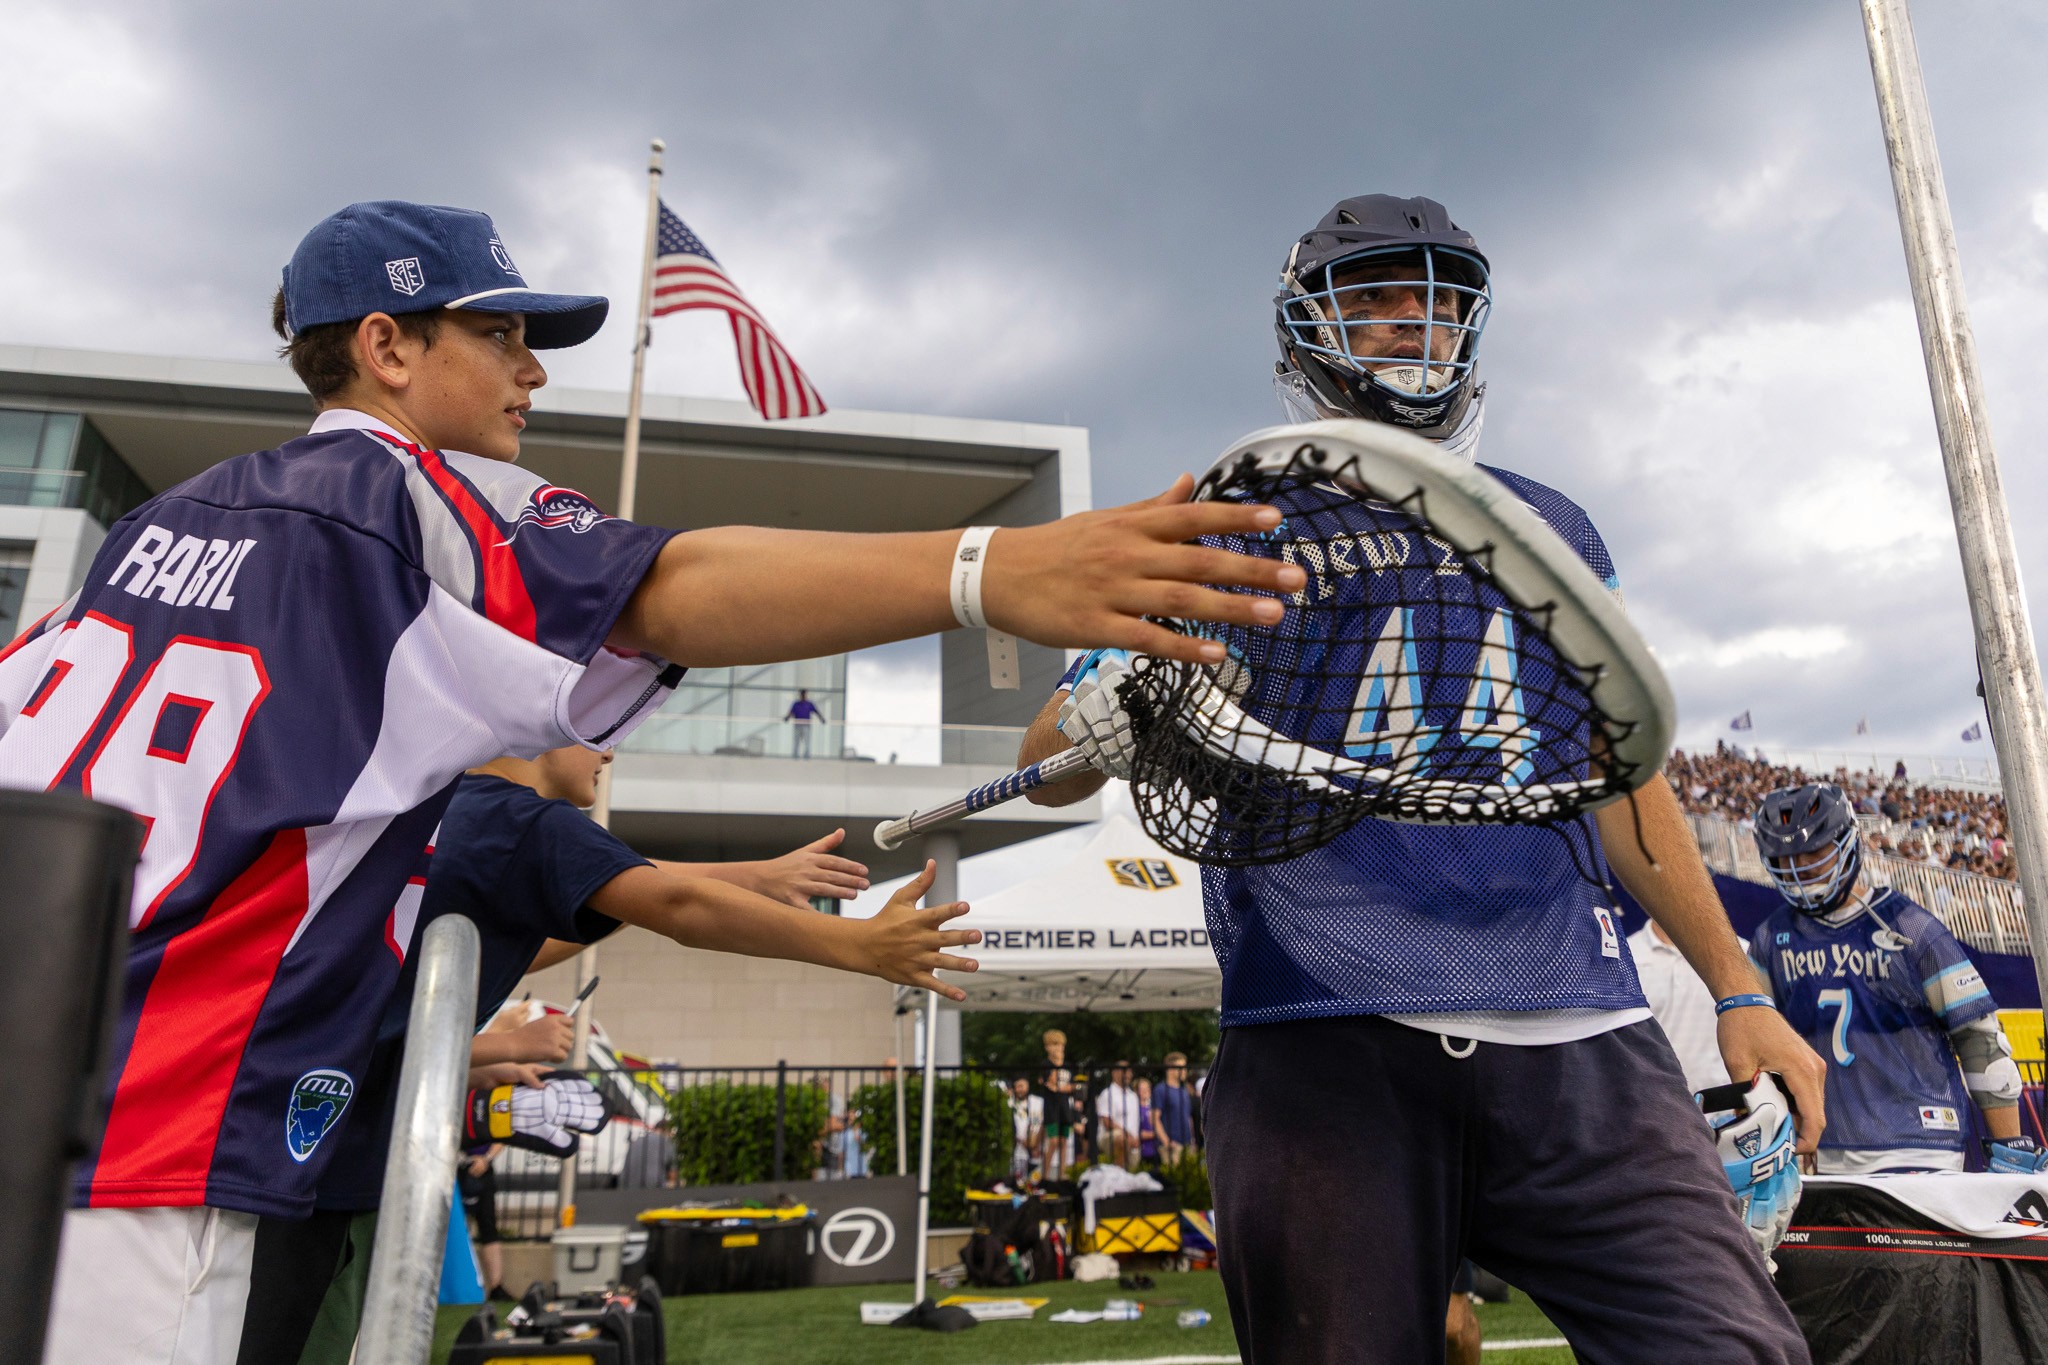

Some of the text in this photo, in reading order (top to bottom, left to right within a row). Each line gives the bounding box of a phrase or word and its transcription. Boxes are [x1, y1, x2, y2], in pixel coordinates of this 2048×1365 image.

[107, 524, 257, 611] RABIL
[1343, 606, 1541, 788] 44
[962, 929, 1096, 949] REMIER
[1776, 932, 1790, 945] CR
[1831, 943, 1893, 979] York
[1818, 988, 1855, 1067] 7
[301, 1077, 350, 1096] MLL
[1750, 1128, 1796, 1184] STX
[2007, 1140, 2025, 1149] NEW
[1782, 1233, 1809, 1242] USKY
[1865, 1234, 1890, 1244] 1000
